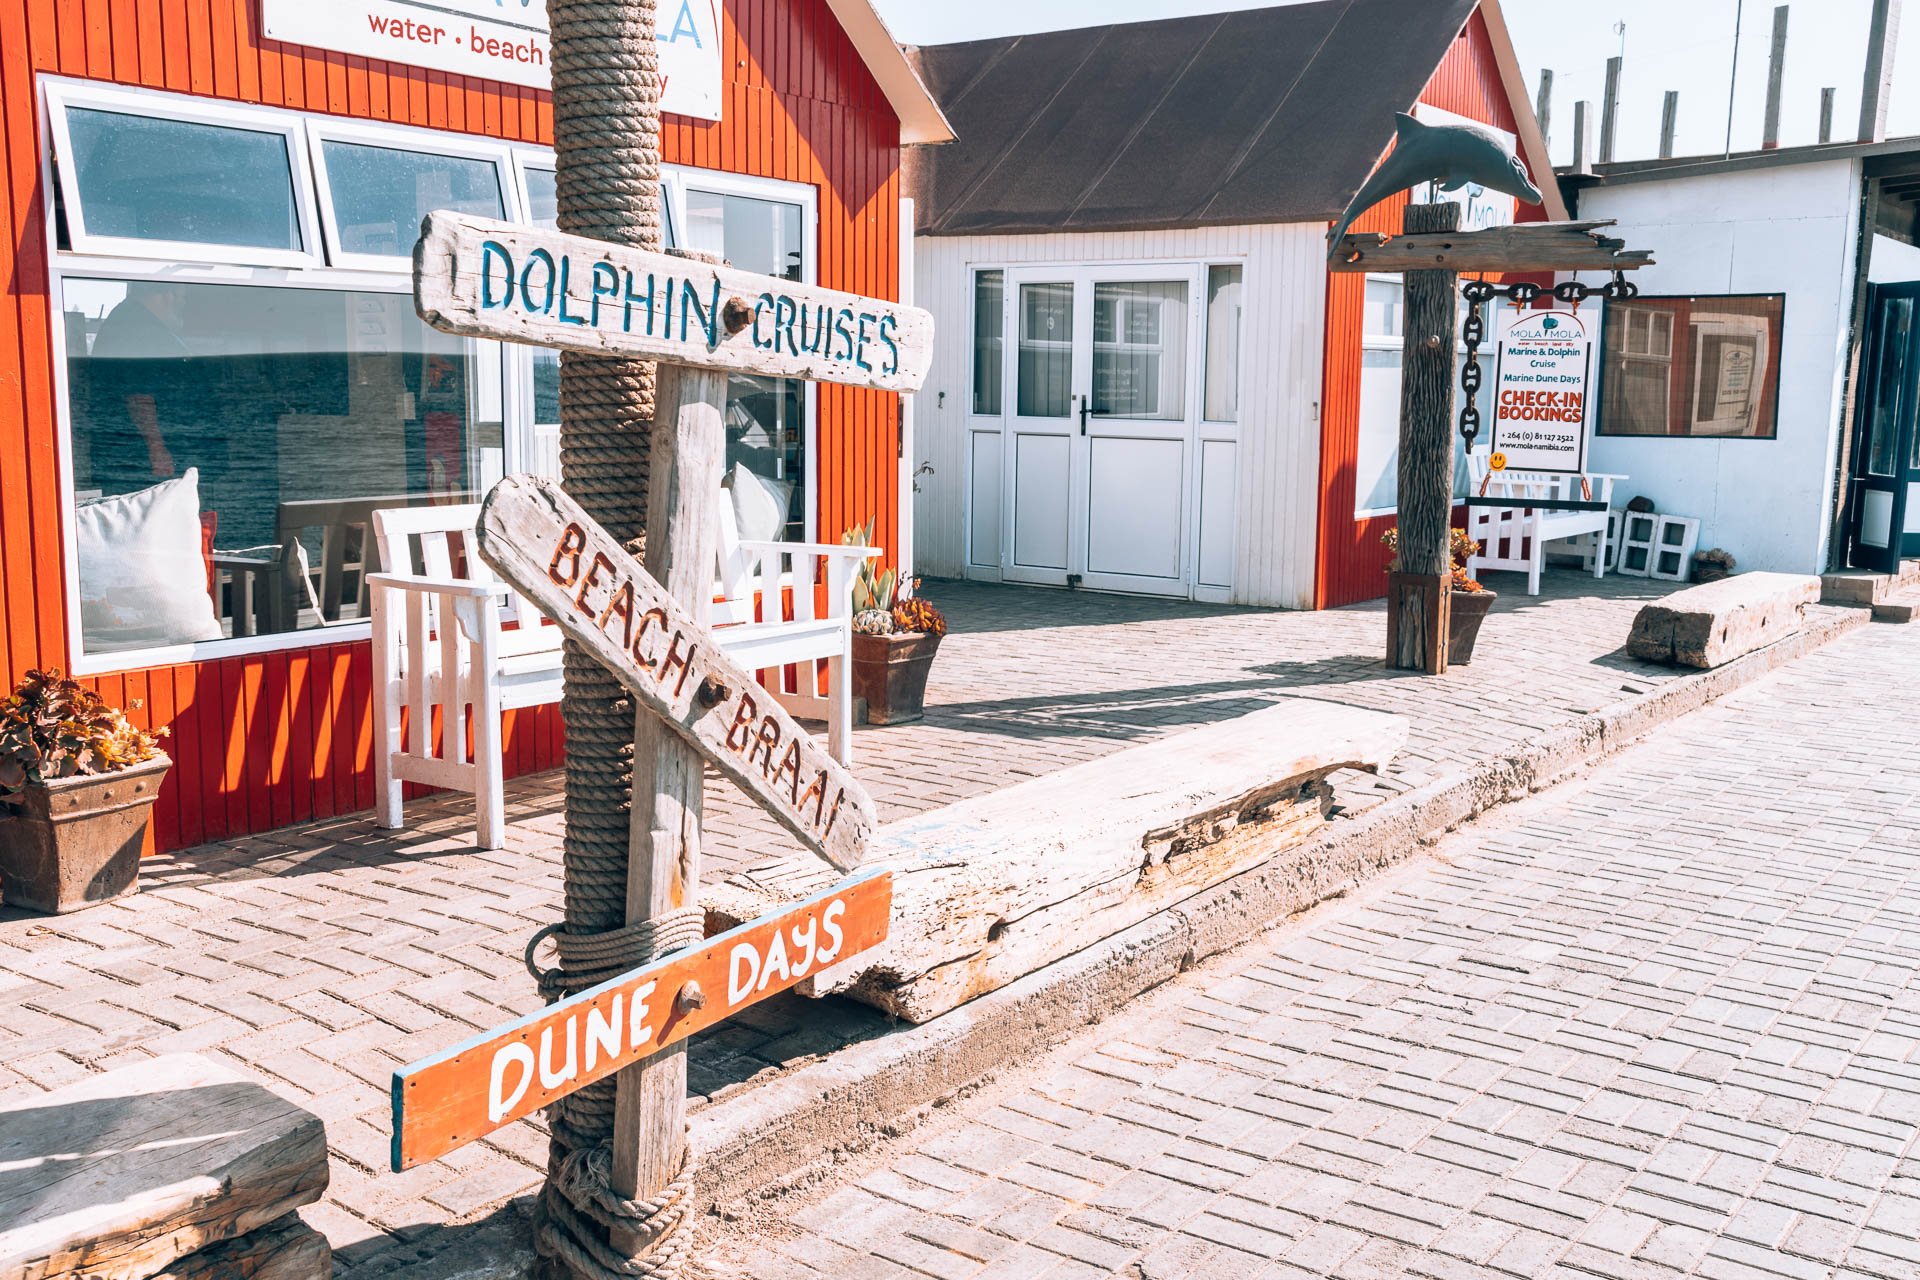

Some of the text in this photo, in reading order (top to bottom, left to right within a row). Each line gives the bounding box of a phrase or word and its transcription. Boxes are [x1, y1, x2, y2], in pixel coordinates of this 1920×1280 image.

[368, 14, 544, 65] water beach
[481, 240, 898, 375] DOLPHIN CRUISES
[1510, 330, 1582, 339] MOLA MOLA
[1508, 347, 1580, 359] Marine & Dolphin
[1530, 360, 1556, 368] Cruise
[1503, 373, 1581, 384] Marine Dune Days
[1501, 389, 1582, 407] CHECK-IN
[1498, 405, 1582, 423] BOOKINGS
[1507, 432, 1521, 440] 264
[1522, 431, 1533, 441] (0)
[1535, 432, 1543, 440] 81
[1557, 434, 1574, 443] 2522
[548, 522, 844, 840] BEACH BRAAI
[488, 898, 846, 1124] DUNE DAYS
